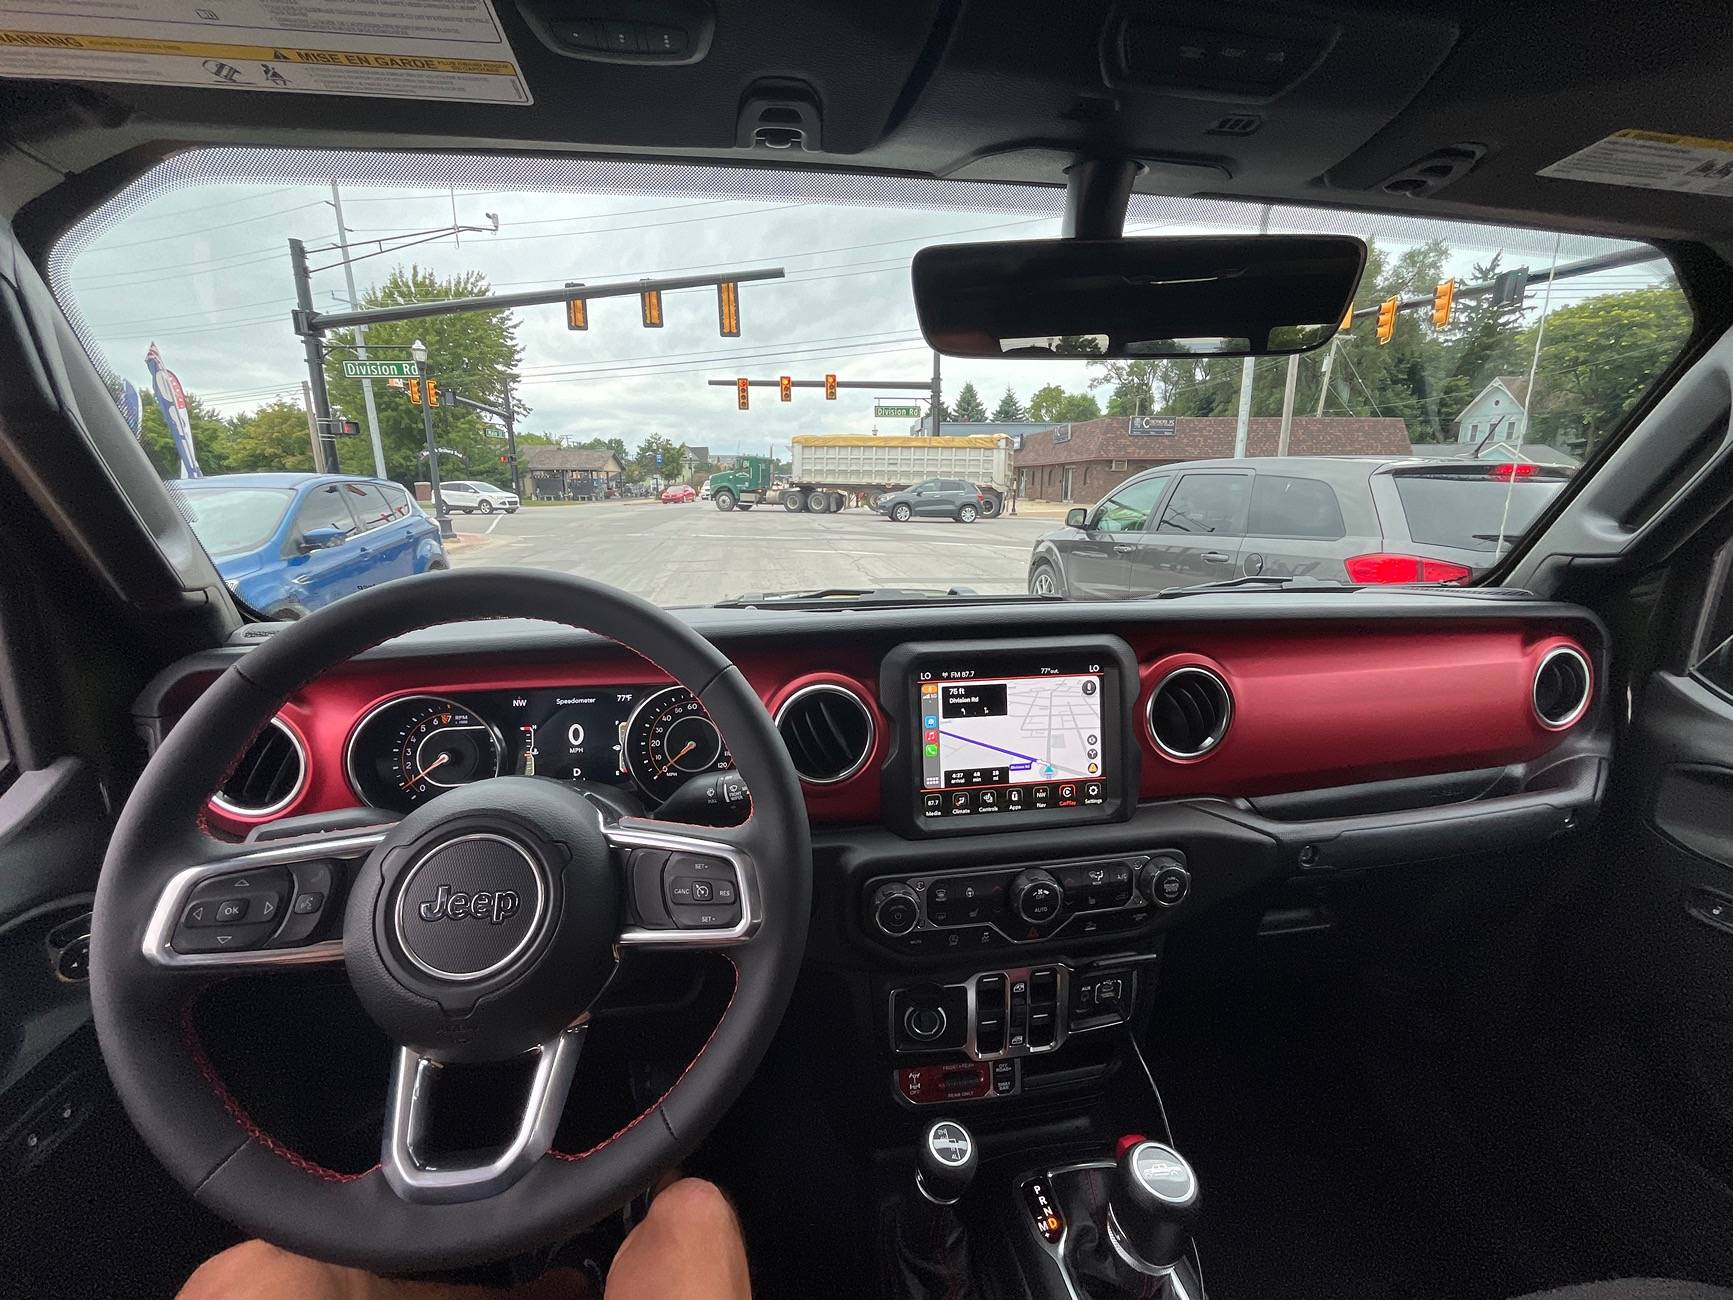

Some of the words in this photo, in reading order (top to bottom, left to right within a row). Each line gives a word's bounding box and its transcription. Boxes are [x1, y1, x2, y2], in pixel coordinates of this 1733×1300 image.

[0, 33, 84, 48] ARNING
[297, 51, 336, 66] MISE
[344, 54, 370, 66] EN
[374, 56, 438, 70] GARDE
[347, 363, 398, 375] Division
[403, 364, 418, 375] Rd
[568, 724, 584, 745] 0
[420, 885, 519, 924] Jeep
[225, 906, 239, 915] OK
[1034, 1185, 1040, 1194] P
[1038, 1196, 1047, 1205] R
[1043, 1206, 1053, 1216] N
[1048, 1218, 1057, 1229] D
